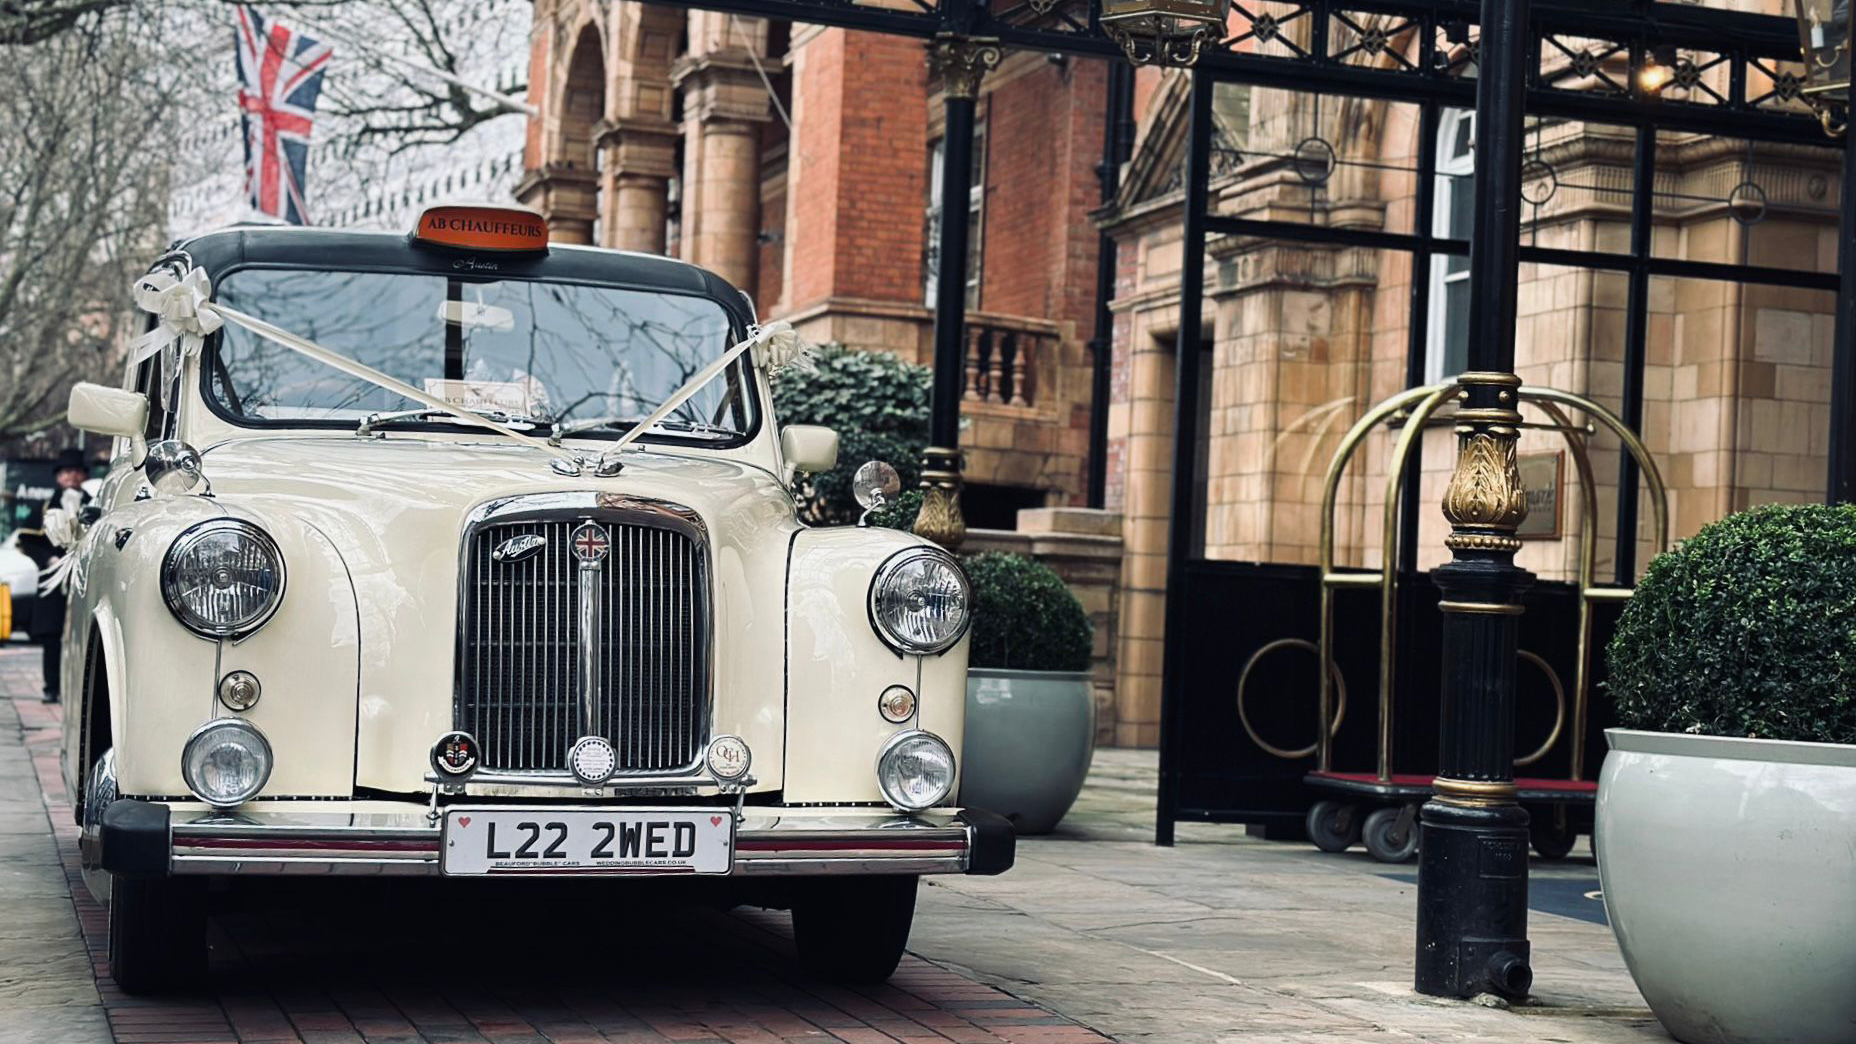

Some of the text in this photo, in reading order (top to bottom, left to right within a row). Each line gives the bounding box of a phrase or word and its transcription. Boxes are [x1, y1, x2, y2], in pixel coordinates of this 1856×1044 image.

[428, 218, 542, 237] AB CHAUFFEURS
[500, 535, 542, 559] Austin
[487, 822, 696, 859] L22 2WED
